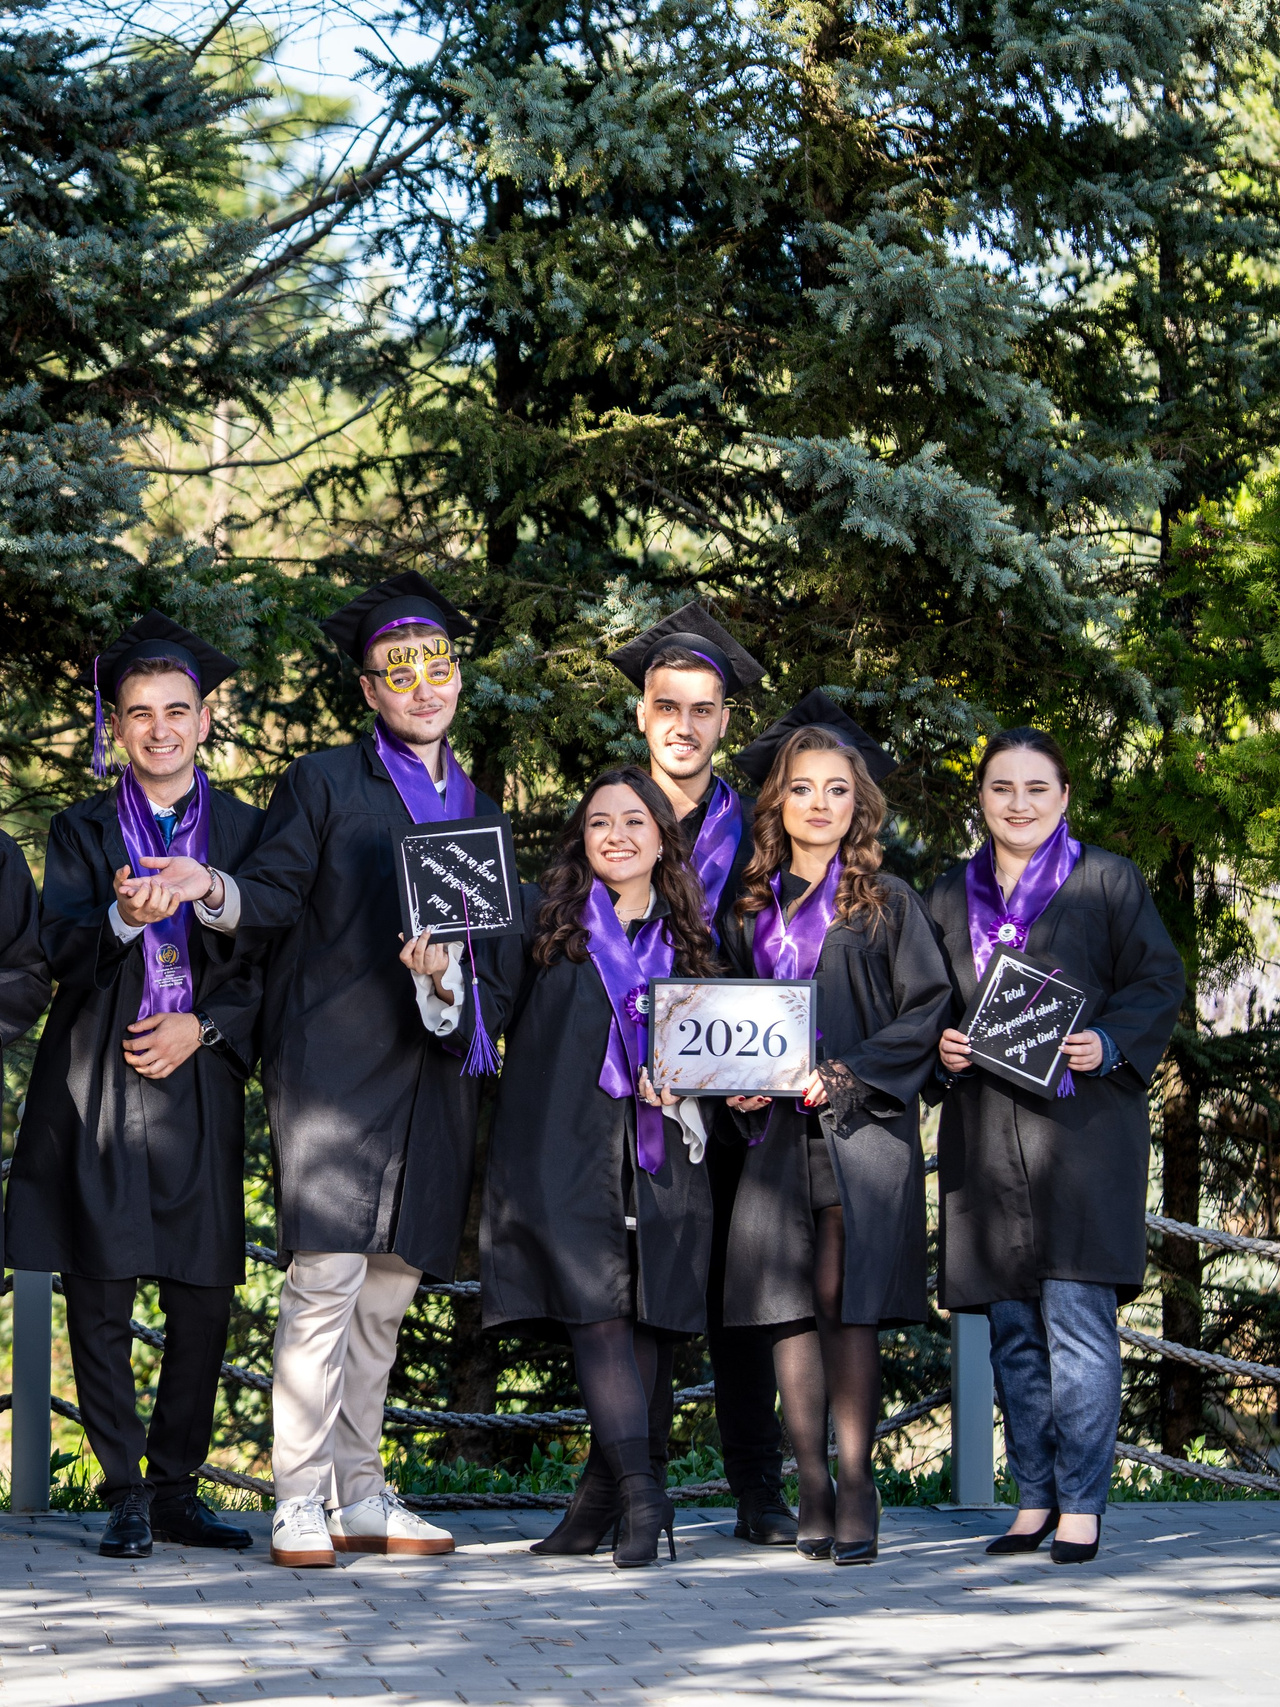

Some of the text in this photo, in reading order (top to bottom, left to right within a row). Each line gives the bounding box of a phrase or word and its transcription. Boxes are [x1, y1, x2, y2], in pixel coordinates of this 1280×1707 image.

[387, 638, 450, 665] GRAD
[427, 894, 452, 916] Totul
[1002, 984, 1025, 1003] Totul
[678, 1018, 788, 1058] 2026
[1036, 1027, 1059, 1043] tine!
